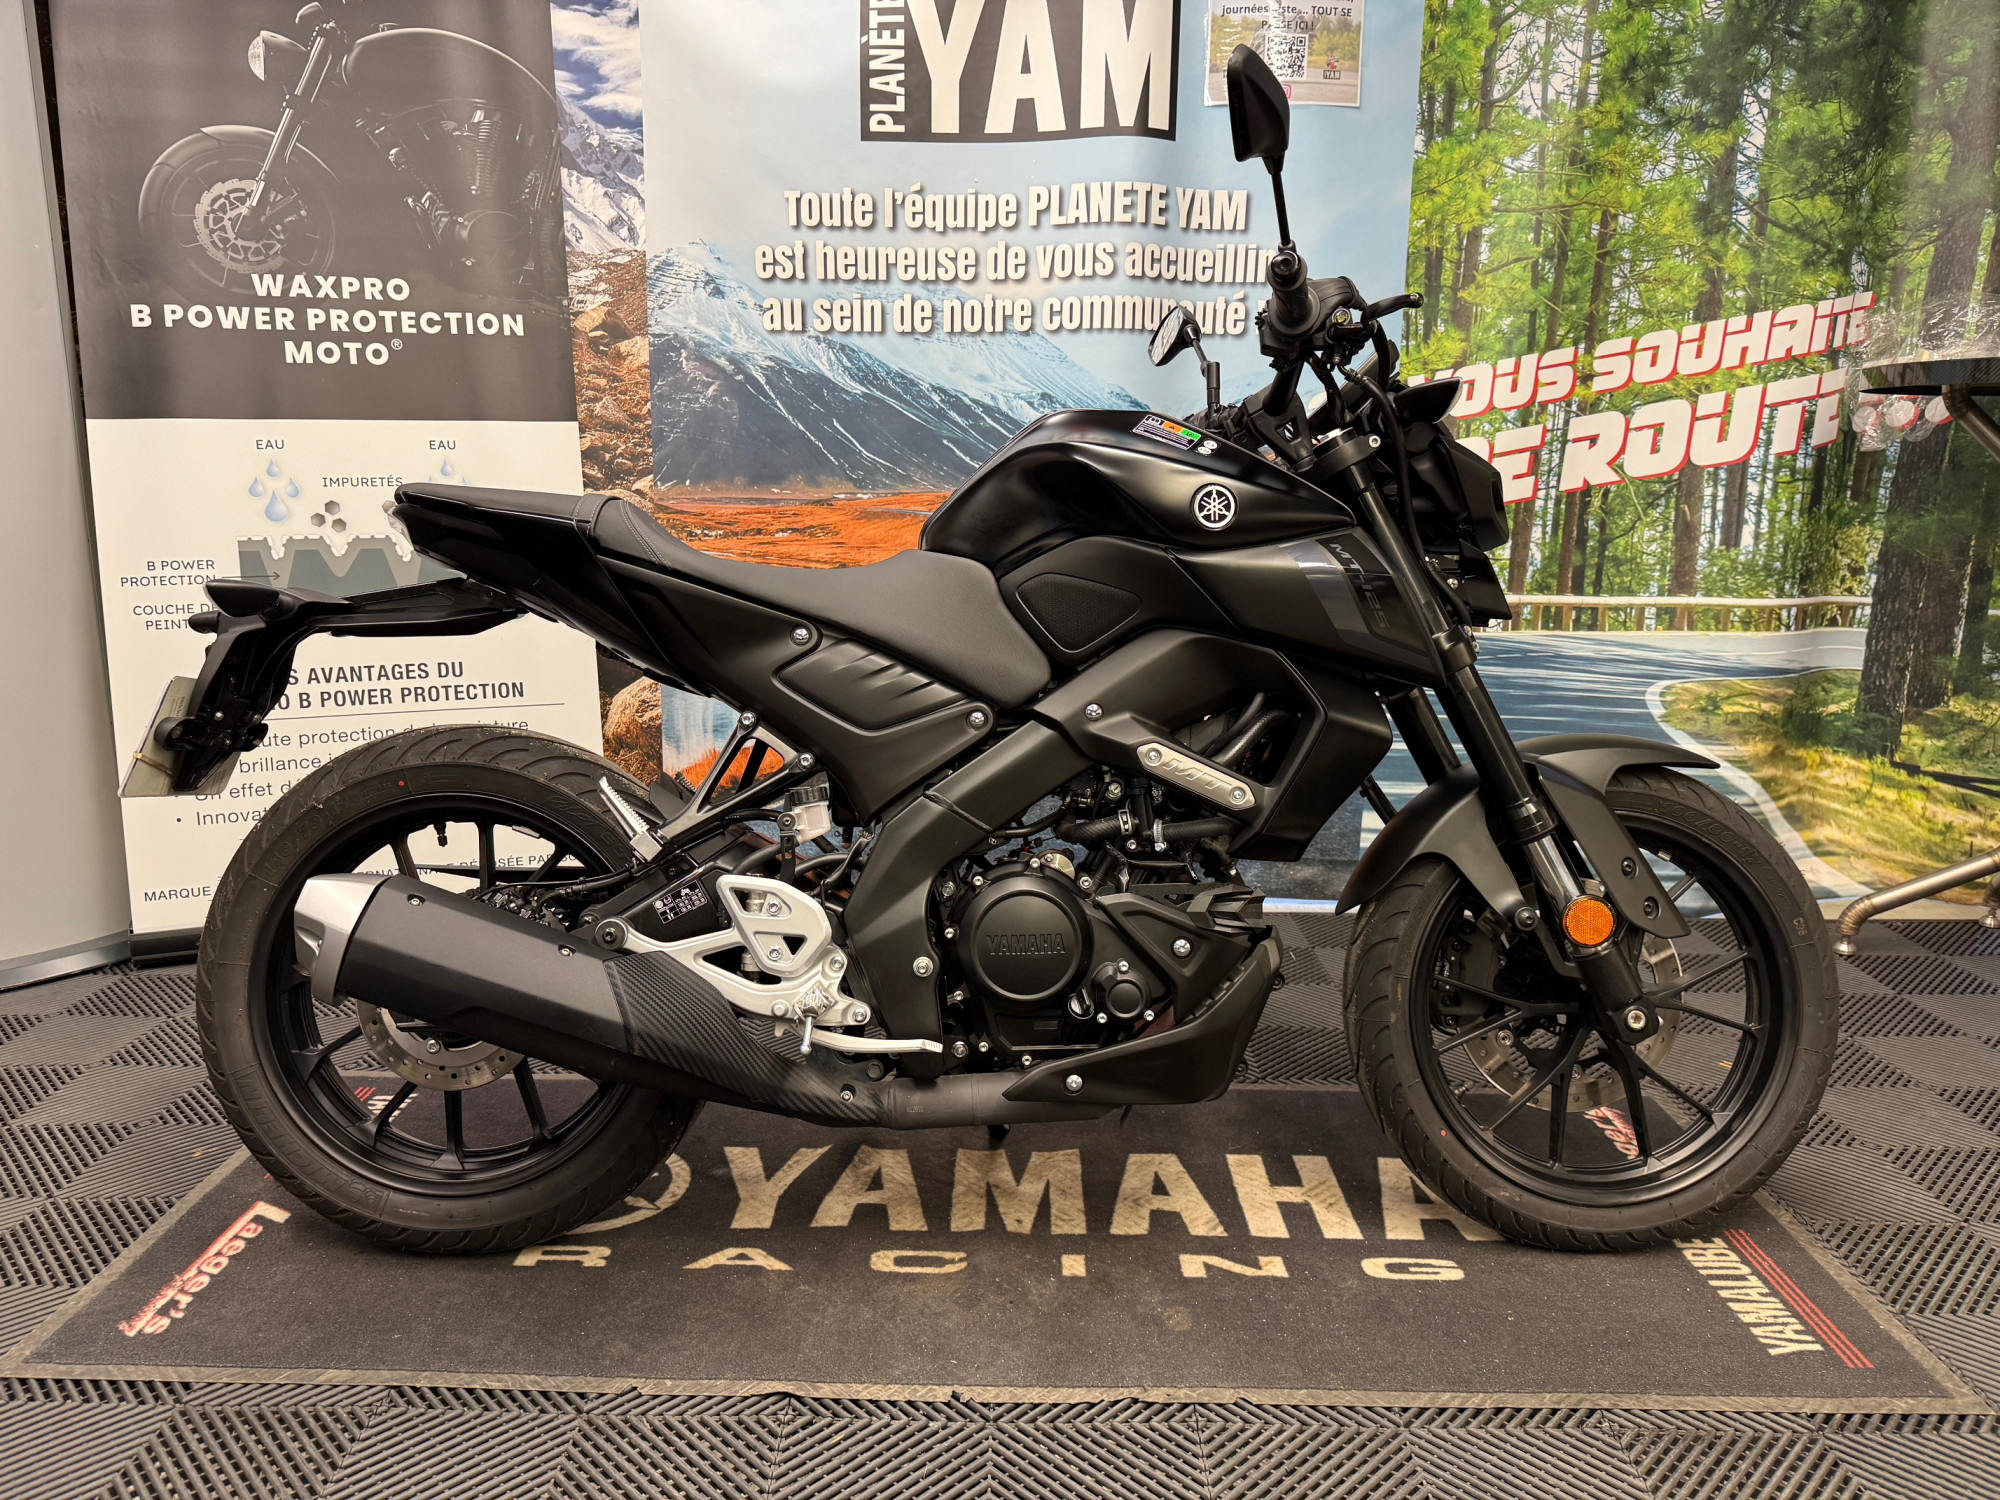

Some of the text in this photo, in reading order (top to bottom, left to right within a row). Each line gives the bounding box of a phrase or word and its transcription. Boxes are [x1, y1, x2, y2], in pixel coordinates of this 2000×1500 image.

[1221, 4, 1269, 17] journées
[1311, 6, 1338, 16] TOUT
[1341, 8, 1352, 17] SE
[906, 0, 1173, 134] YAM
[784, 181, 1248, 232] Toute l'équipe PLANETE YAM
[754, 240, 805, 280] est
[815, 240, 976, 281] heureuse
[986, 241, 1026, 281] de
[1035, 240, 1115, 279] vous
[250, 273, 411, 301] WAXPRO
[129, 304, 525, 337] B POWER PROTECTION
[762, 296, 803, 332] au
[812, 293, 883, 333] sein
[892, 293, 933, 333] de
[943, 293, 1032, 333] notre
[255, 439, 285, 450] EAU
[429, 440, 456, 450] EAU
[322, 474, 403, 487] IMPURETÉS
[147, 559, 215, 571] B POWER
[133, 603, 195, 615] COUCHE
[145, 619, 189, 631] PEINT
[307, 662, 430, 685] AVANTAGES
[437, 661, 464, 678] DU
[299, 692, 312, 709] B
[320, 688, 393, 708] POWER
[400, 681, 525, 704] PROTECTION
[299, 726, 395, 748] protection
[239, 757, 322, 773] brillance
[1162, 758, 1233, 791] MT
[229, 781, 273, 798] effet
[144, 886, 211, 902] MARQUE
[986, 932, 1066, 956] YAMAHA
[726, 1141, 1502, 1242] YAMAHA
[513, 1245, 1465, 1281] RACING
[1673, 1237, 1825, 1355] YAMALUBE
